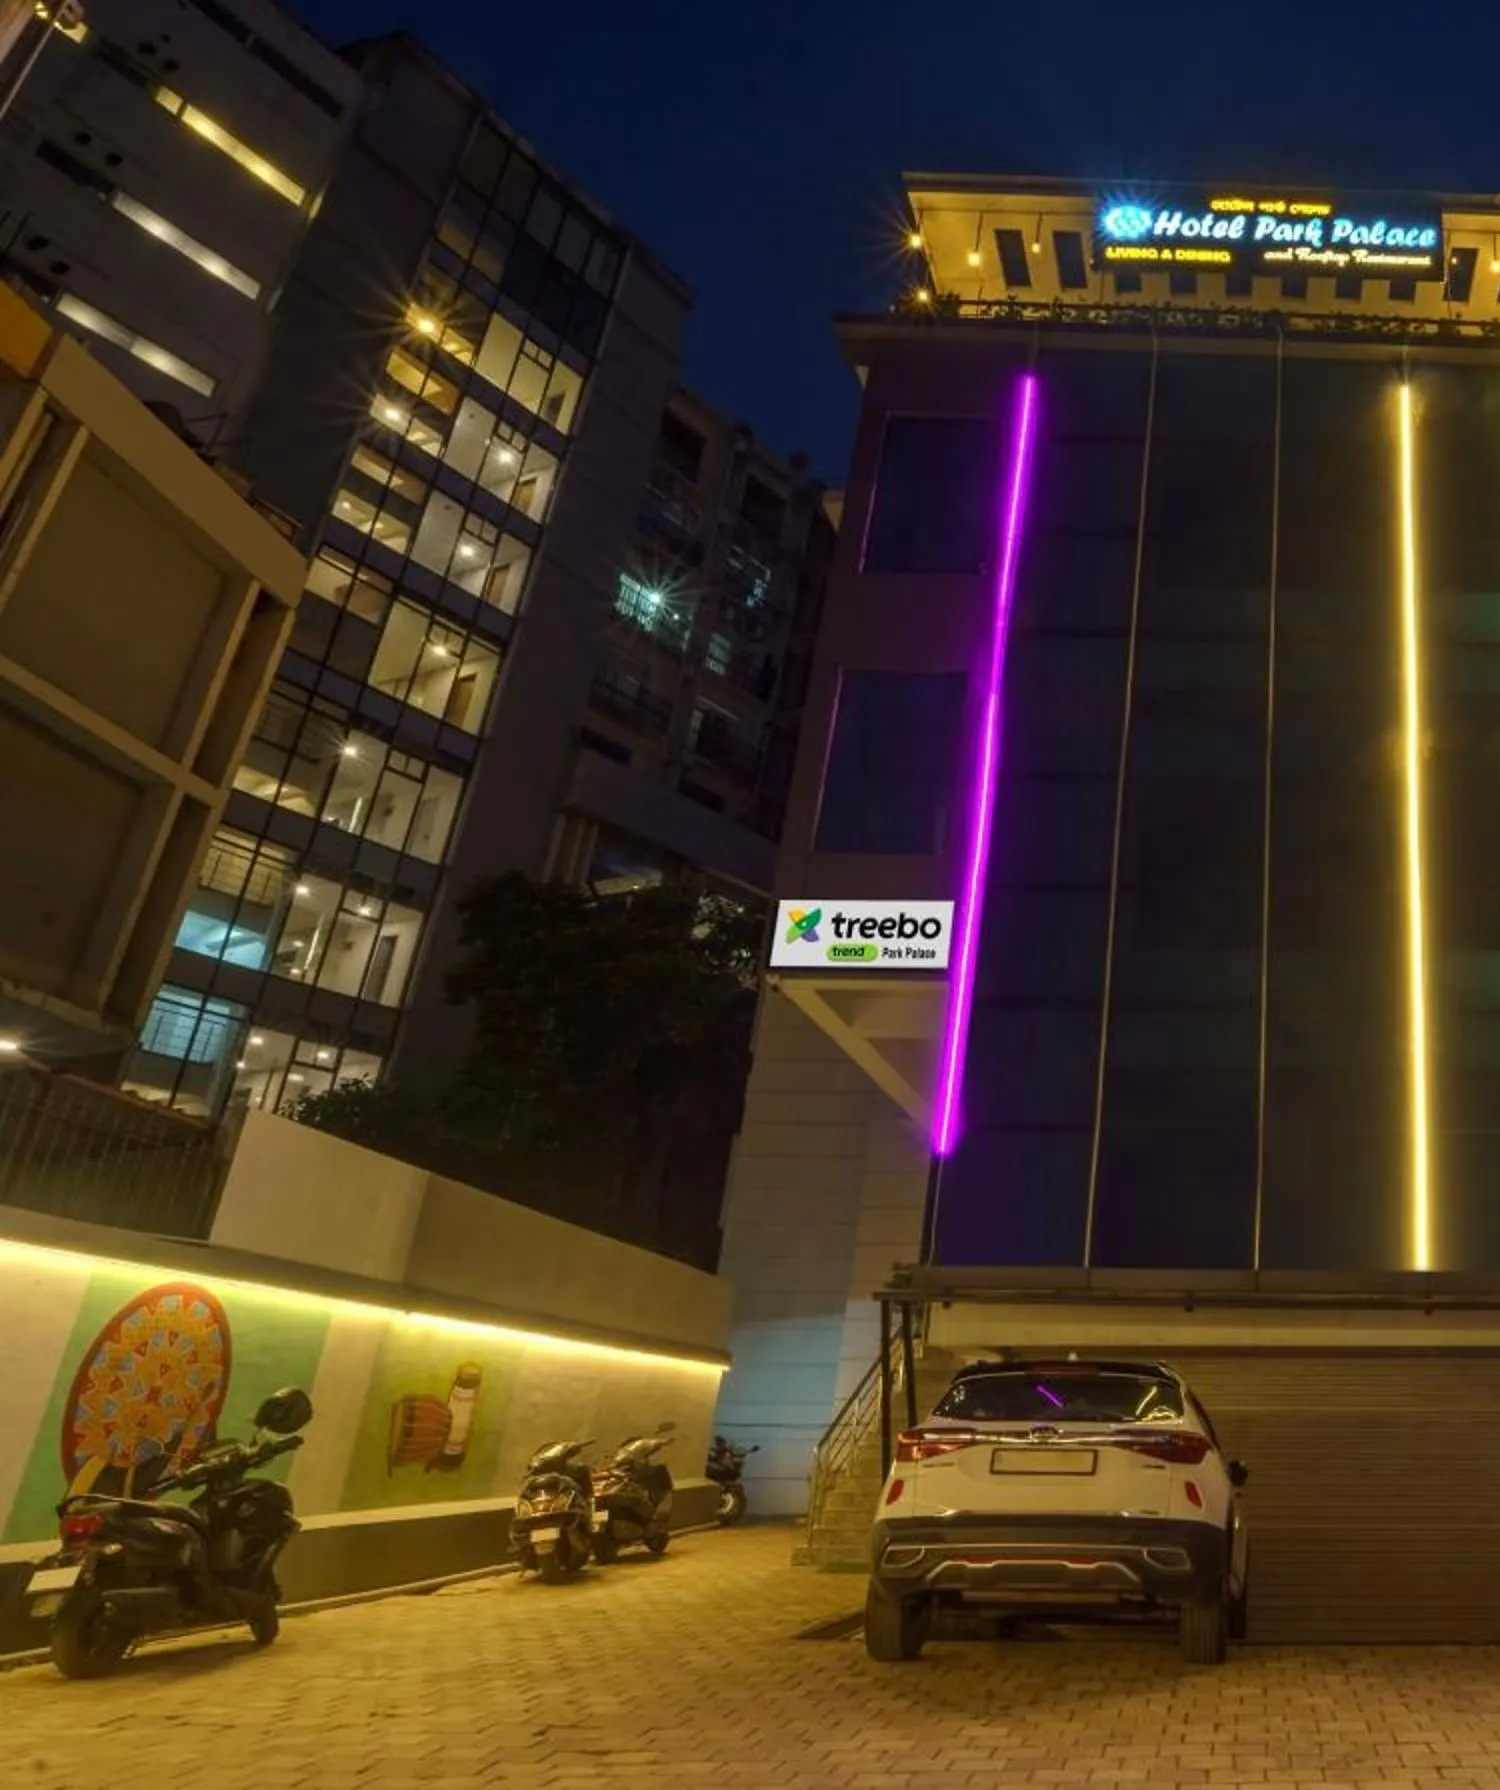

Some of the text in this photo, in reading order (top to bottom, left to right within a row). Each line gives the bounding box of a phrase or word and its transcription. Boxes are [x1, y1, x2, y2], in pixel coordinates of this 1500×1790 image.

[1153, 210, 1437, 247] Hotel Park Palace
[1105, 247, 1158, 259] LIVING
[1175, 249, 1232, 263] DINING
[831, 912, 942, 939] treebo
[832, 946, 865, 957] trend
[881, 947, 937, 959] Park Palace
